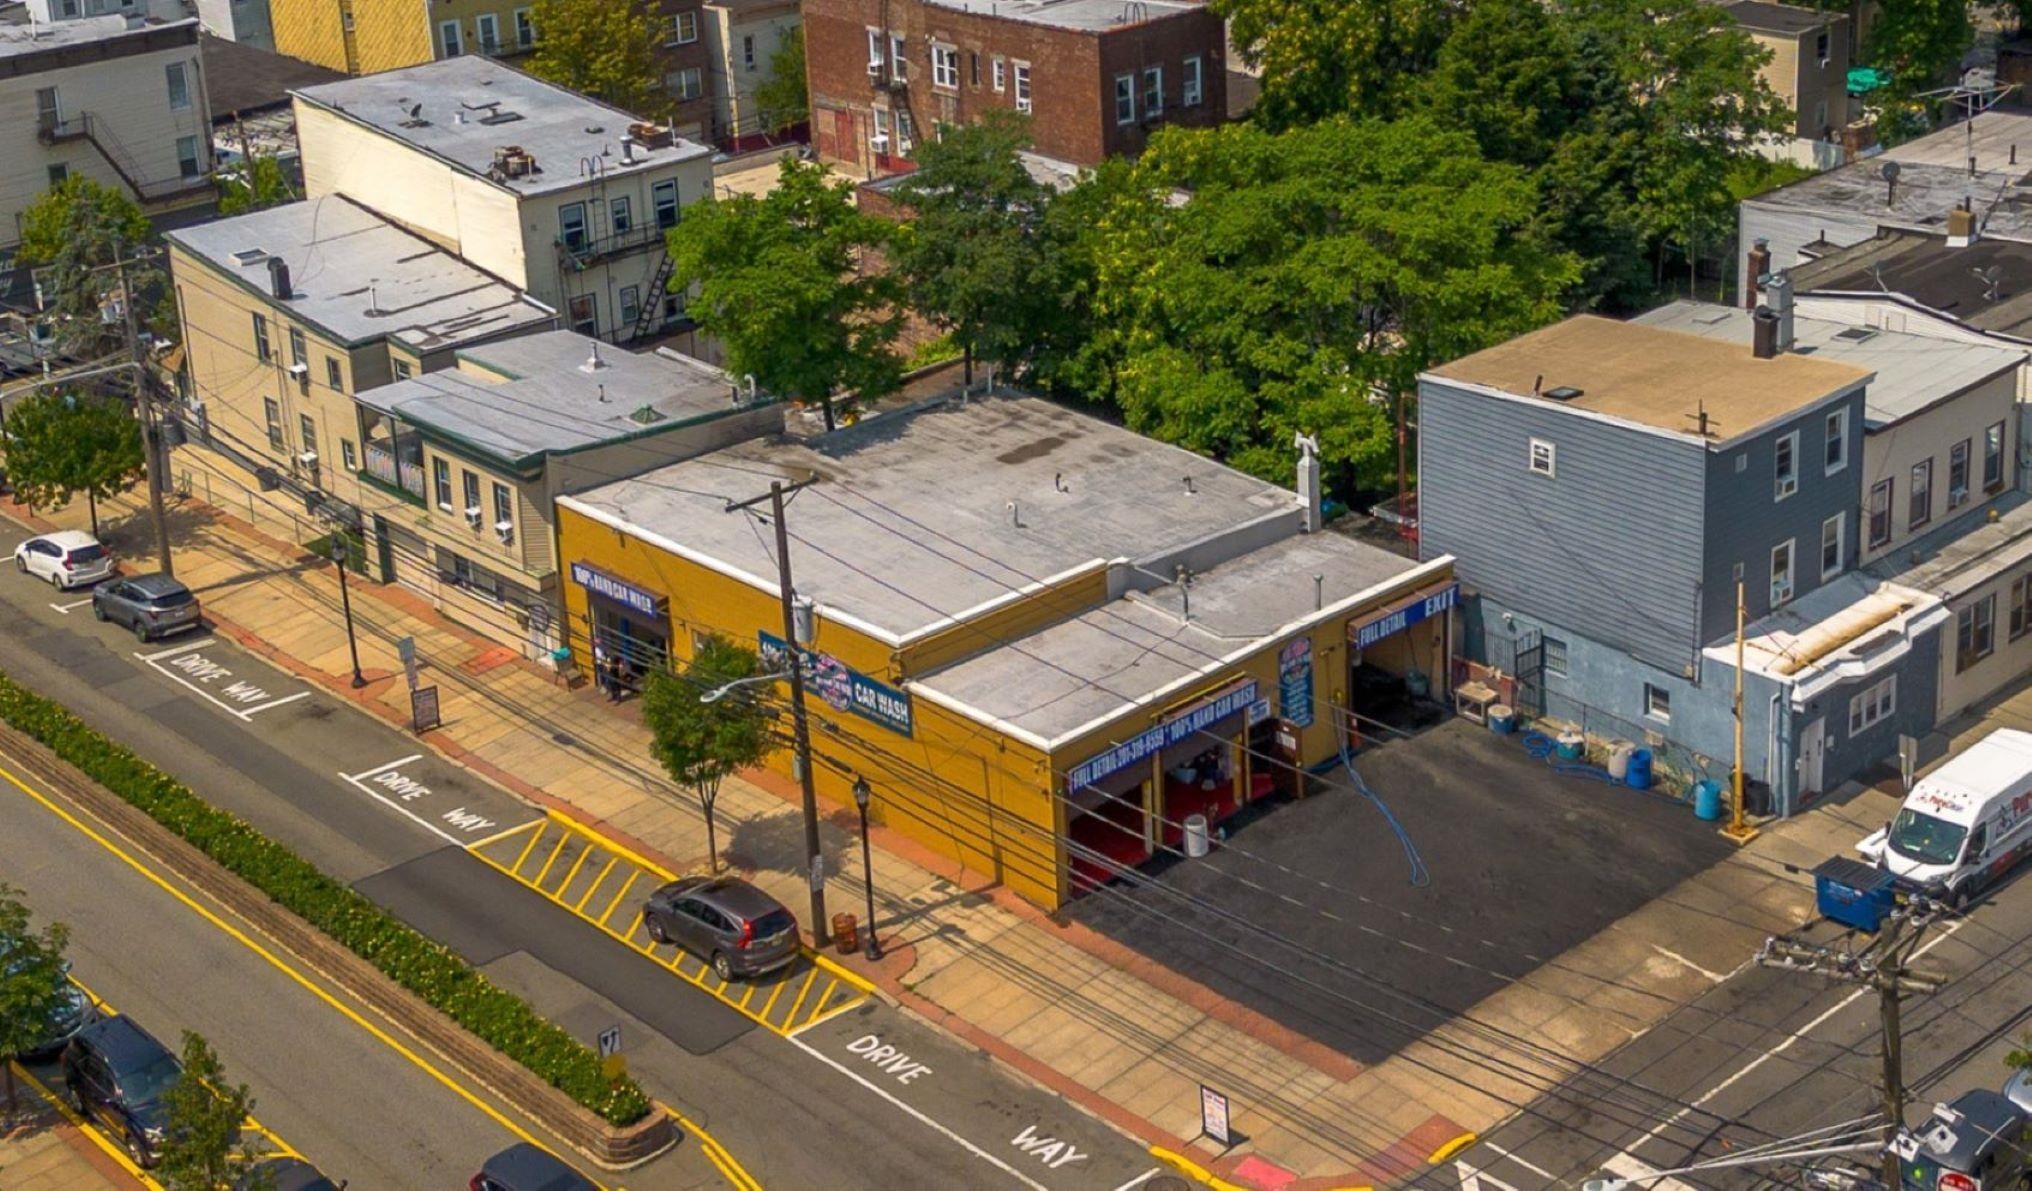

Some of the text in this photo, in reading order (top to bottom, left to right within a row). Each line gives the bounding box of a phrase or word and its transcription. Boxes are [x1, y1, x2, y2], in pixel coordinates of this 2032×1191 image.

[1361, 587, 1456, 647] FULL DETAIL EXIT
[170, 653, 272, 702] DRIVE WAY
[855, 682, 877, 710] CAR
[877, 693, 909, 725] WASH
[1074, 764, 1091, 791] FULL
[1193, 707, 1214, 731] HAND
[1215, 698, 1231, 720] CAR
[1232, 684, 1256, 711] WASH
[373, 771, 496, 832] DRIVE WAY
[846, 1034, 1087, 1168] DRIVE WAY
